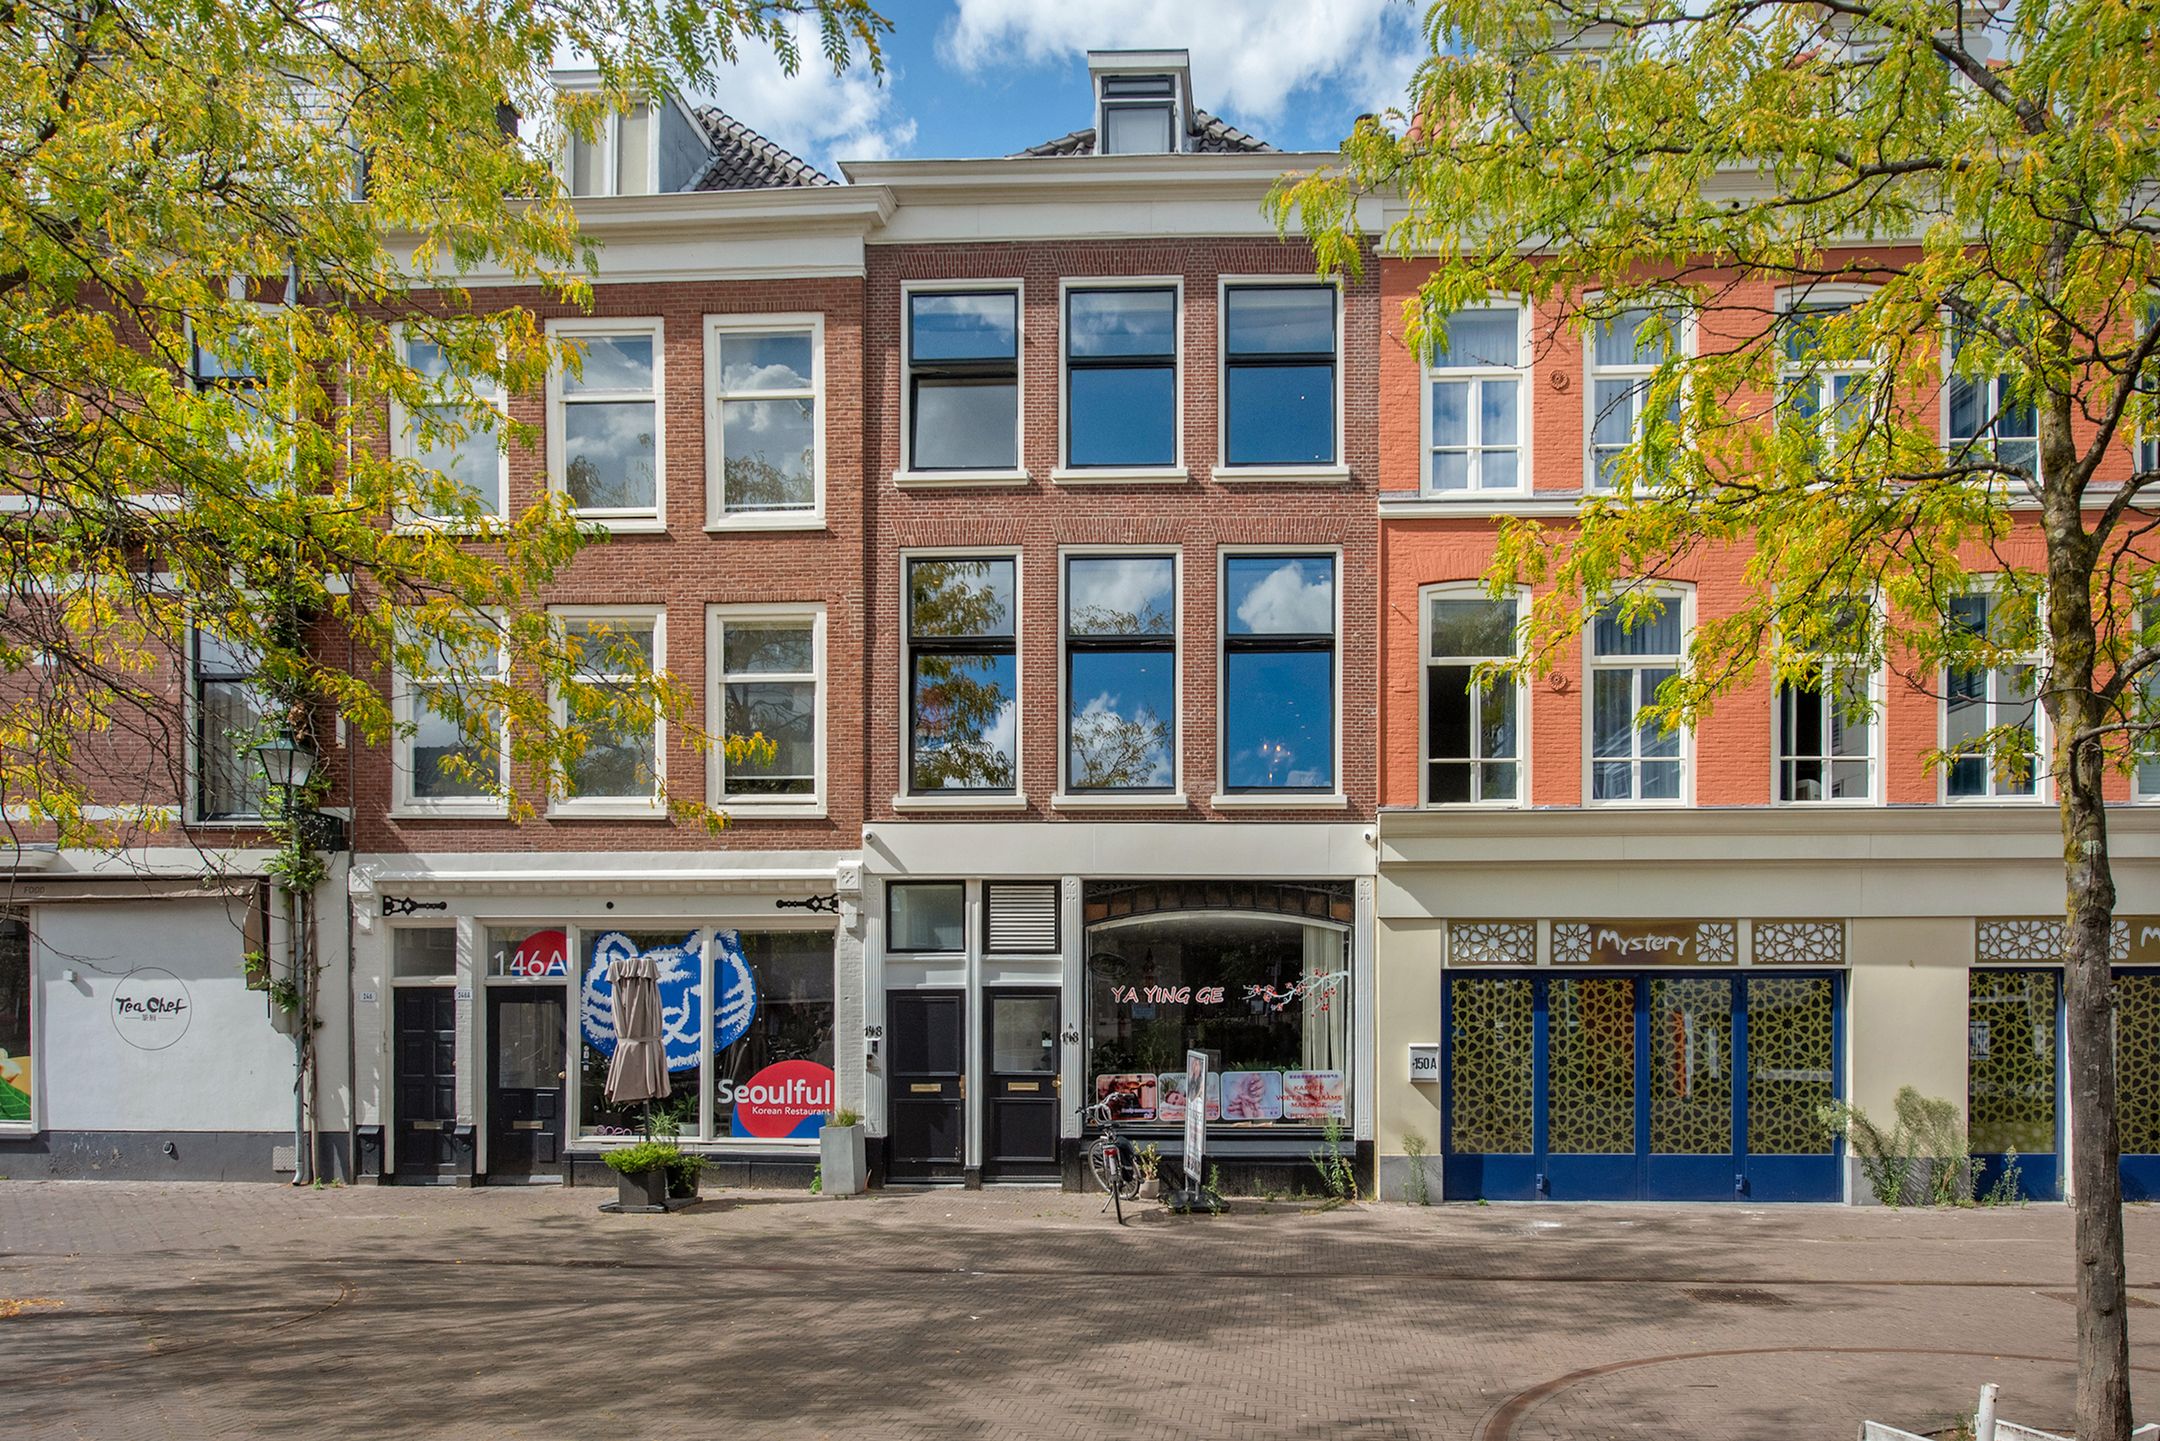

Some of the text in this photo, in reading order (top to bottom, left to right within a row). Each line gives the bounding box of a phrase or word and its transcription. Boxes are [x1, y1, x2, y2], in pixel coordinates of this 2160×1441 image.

[1597, 929, 1690, 956] Mystery
[494, 949, 568, 977] 146A
[1111, 984, 1225, 1005] YA YING GE
[115, 997, 188, 1015] Tea Chef
[865, 1025, 883, 1037] 148
[1061, 1031, 1079, 1043] 148
[717, 1079, 831, 1105] Seoulful
[752, 1106, 832, 1116] Korean Restaurant
